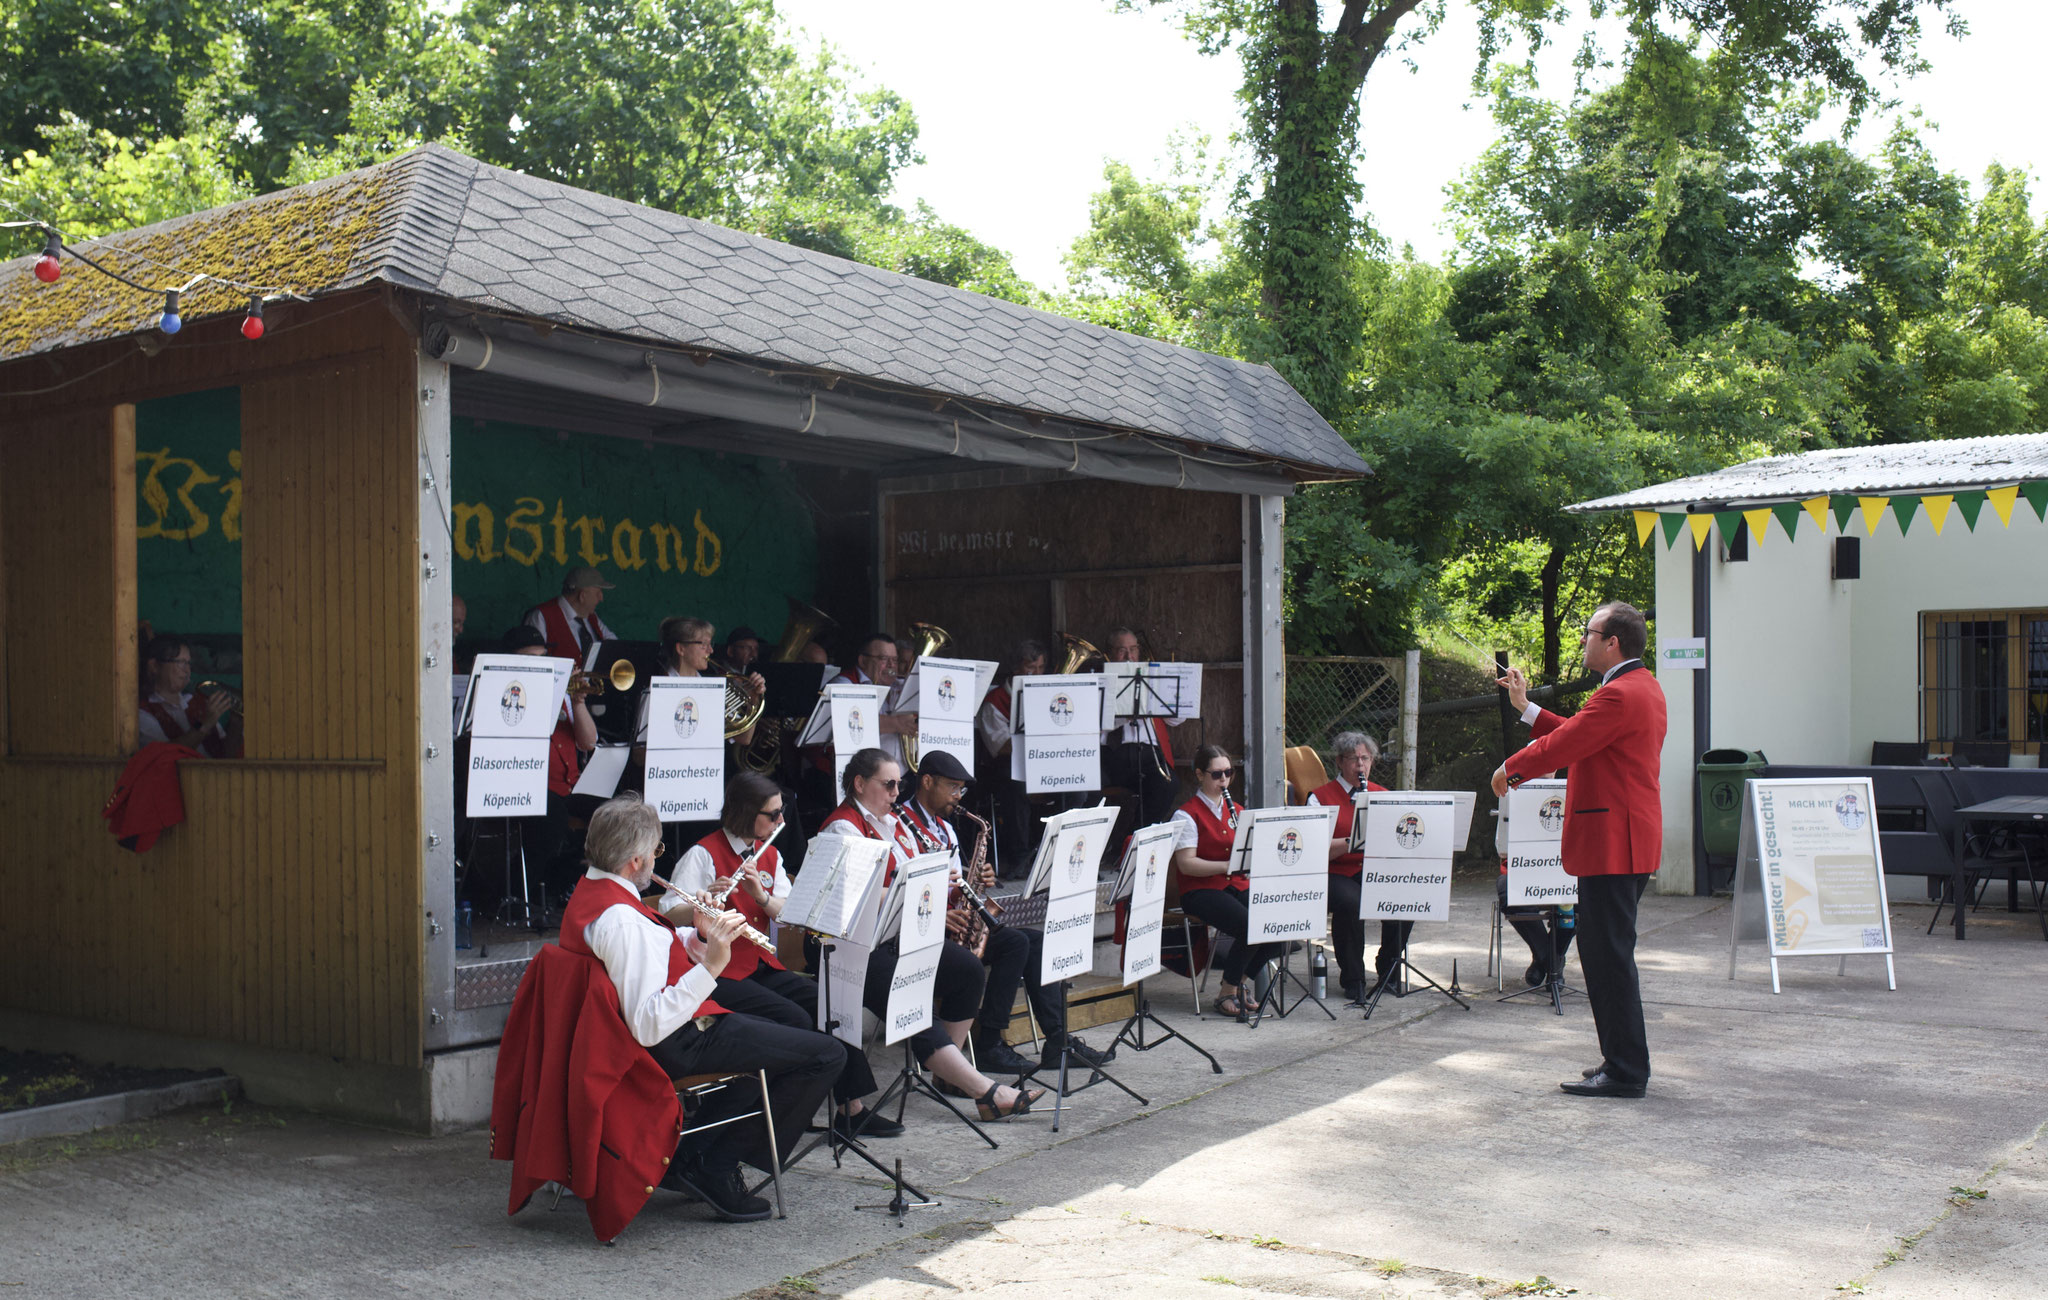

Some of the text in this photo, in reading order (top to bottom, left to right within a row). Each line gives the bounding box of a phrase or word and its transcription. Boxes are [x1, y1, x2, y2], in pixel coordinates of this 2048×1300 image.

[1685, 649, 1698, 658] WC
[921, 733, 972, 747] Blasorchester
[1028, 747, 1097, 760] Blasorchester
[472, 756, 545, 770] Blasorchester
[648, 765, 721, 779] Blasorchester
[1040, 773, 1086, 787] Köpenick
[483, 792, 532, 809] Köpenick
[660, 798, 709, 815] Köpenick
[1788, 800, 1834, 809] MACH MIT
[1759, 790, 1782, 858] gesucht!
[1511, 855, 1562, 868] Blasorch
[1365, 872, 1447, 884] Blasorchester
[1252, 890, 1325, 905] Blasorchester
[1525, 884, 1578, 899] Köpenick
[1377, 901, 1431, 914] Köpenick
[1046, 912, 1093, 935] Blasorchester
[1128, 919, 1161, 941] Blasorchester
[1263, 919, 1311, 935] Köpenick
[1052, 949, 1083, 972] Köpenick
[1131, 952, 1154, 975] Köpenick
[892, 965, 936, 991] Blasorchester
[895, 1005, 924, 1030] Köpenick
